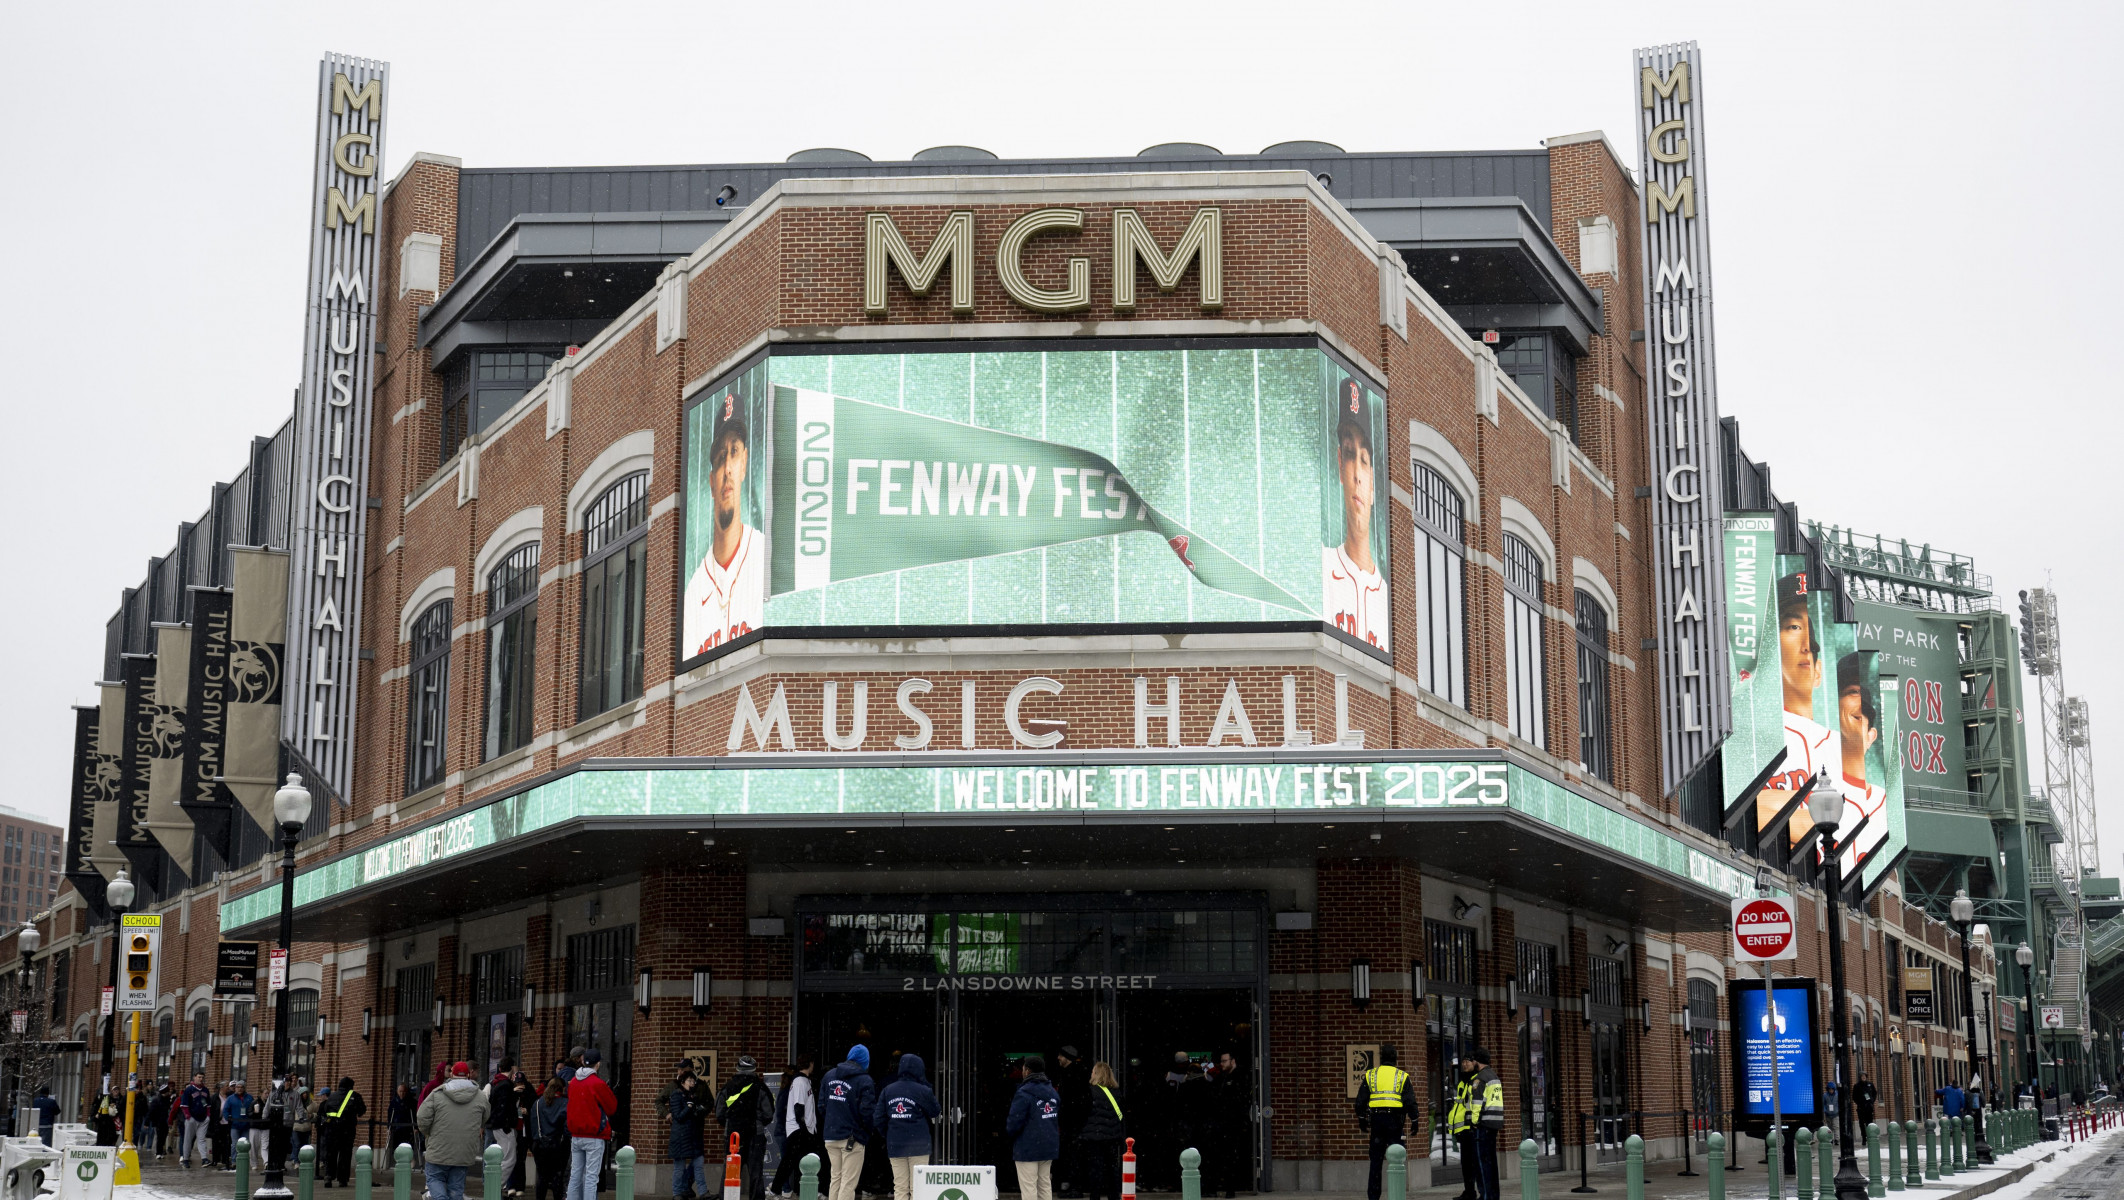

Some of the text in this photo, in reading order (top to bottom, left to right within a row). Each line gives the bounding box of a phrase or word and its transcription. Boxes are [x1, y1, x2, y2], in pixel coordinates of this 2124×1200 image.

[864, 206, 1223, 318] MGM
[313, 73, 381, 741] MGM MUSIC HALL
[1641, 61, 1703, 732] MGM MUSIC HALL
[800, 421, 831, 557] 2025
[847, 459, 1036, 517] FENWAY
[1734, 535, 1757, 660] FENWAY FEST
[1856, 623, 1940, 651] AY PARK
[1878, 652, 1917, 668] OF THE
[197, 610, 229, 801] MGM MUSIC HALL
[726, 673, 1366, 751] MUSIC HALL
[1904, 677, 1945, 725] ON
[130, 674, 157, 842] MGM MUSIC HALL
[1899, 729, 1948, 774] OX
[952, 765, 1508, 809] WELCOME TO FENWAY FEST 2025
[78, 826, 94, 872] MGM
[364, 814, 475, 882] WELCOME TO FENWAY FEST 2025
[125, 917, 158, 925] SCHOOL
[1741, 911, 1784, 922] DO NOT
[1746, 935, 1782, 945] ENTER
[903, 975, 1157, 991] 2 LANSDOWNE STREET
[70, 1150, 108, 1159] MERIDIAN
[925, 1172, 981, 1185] MERIDIAN
